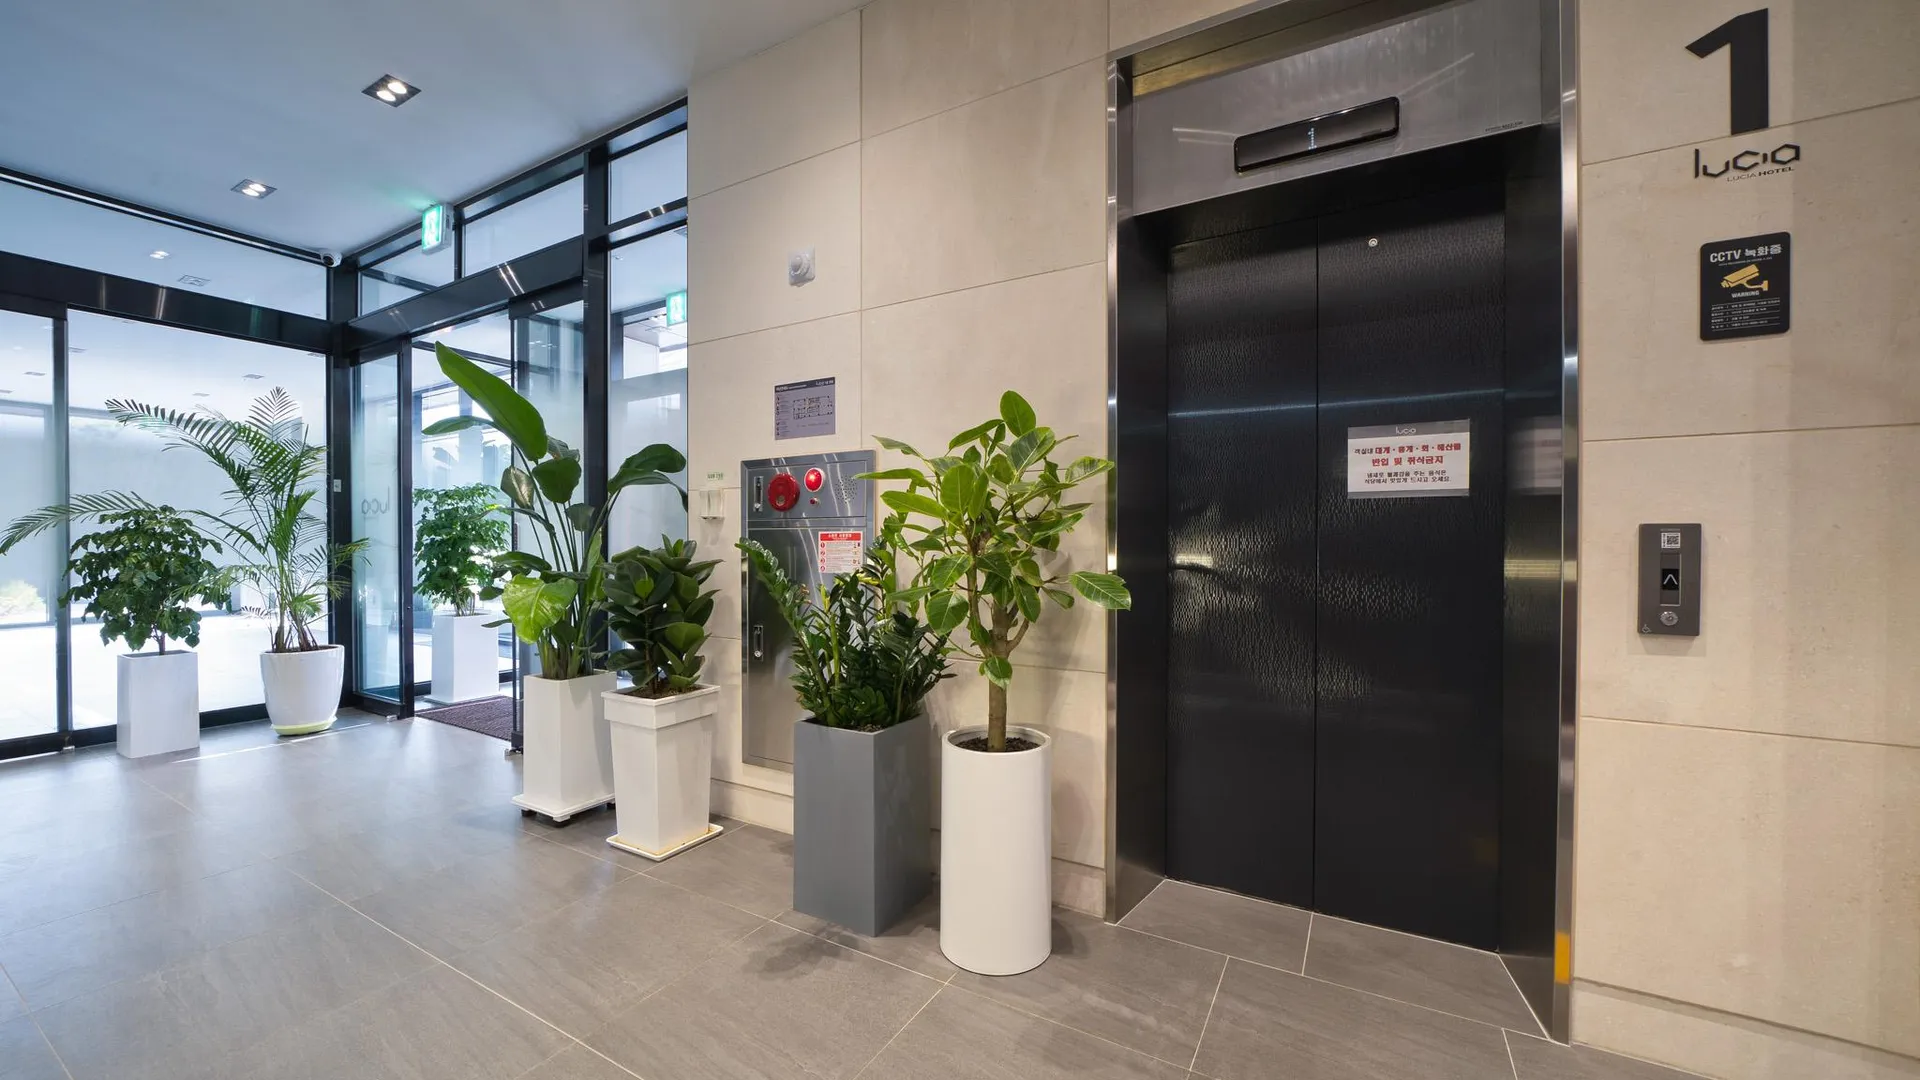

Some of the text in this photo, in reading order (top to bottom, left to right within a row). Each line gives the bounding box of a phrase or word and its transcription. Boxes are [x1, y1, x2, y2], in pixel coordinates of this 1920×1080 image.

[1685, 8, 1769, 135] 1
[1307, 127, 1318, 150] 1
[1694, 144, 1800, 179] lucia
[1726, 166, 1795, 182] LUCIA HOTEL
[1709, 249, 1742, 263] CCTV
[1744, 244, 1782, 257] 녹화중
[1731, 290, 1760, 298] WARNING
[1375, 446, 1390, 454] 대게
[1372, 456, 1443, 466] 반입 및 취식금지
